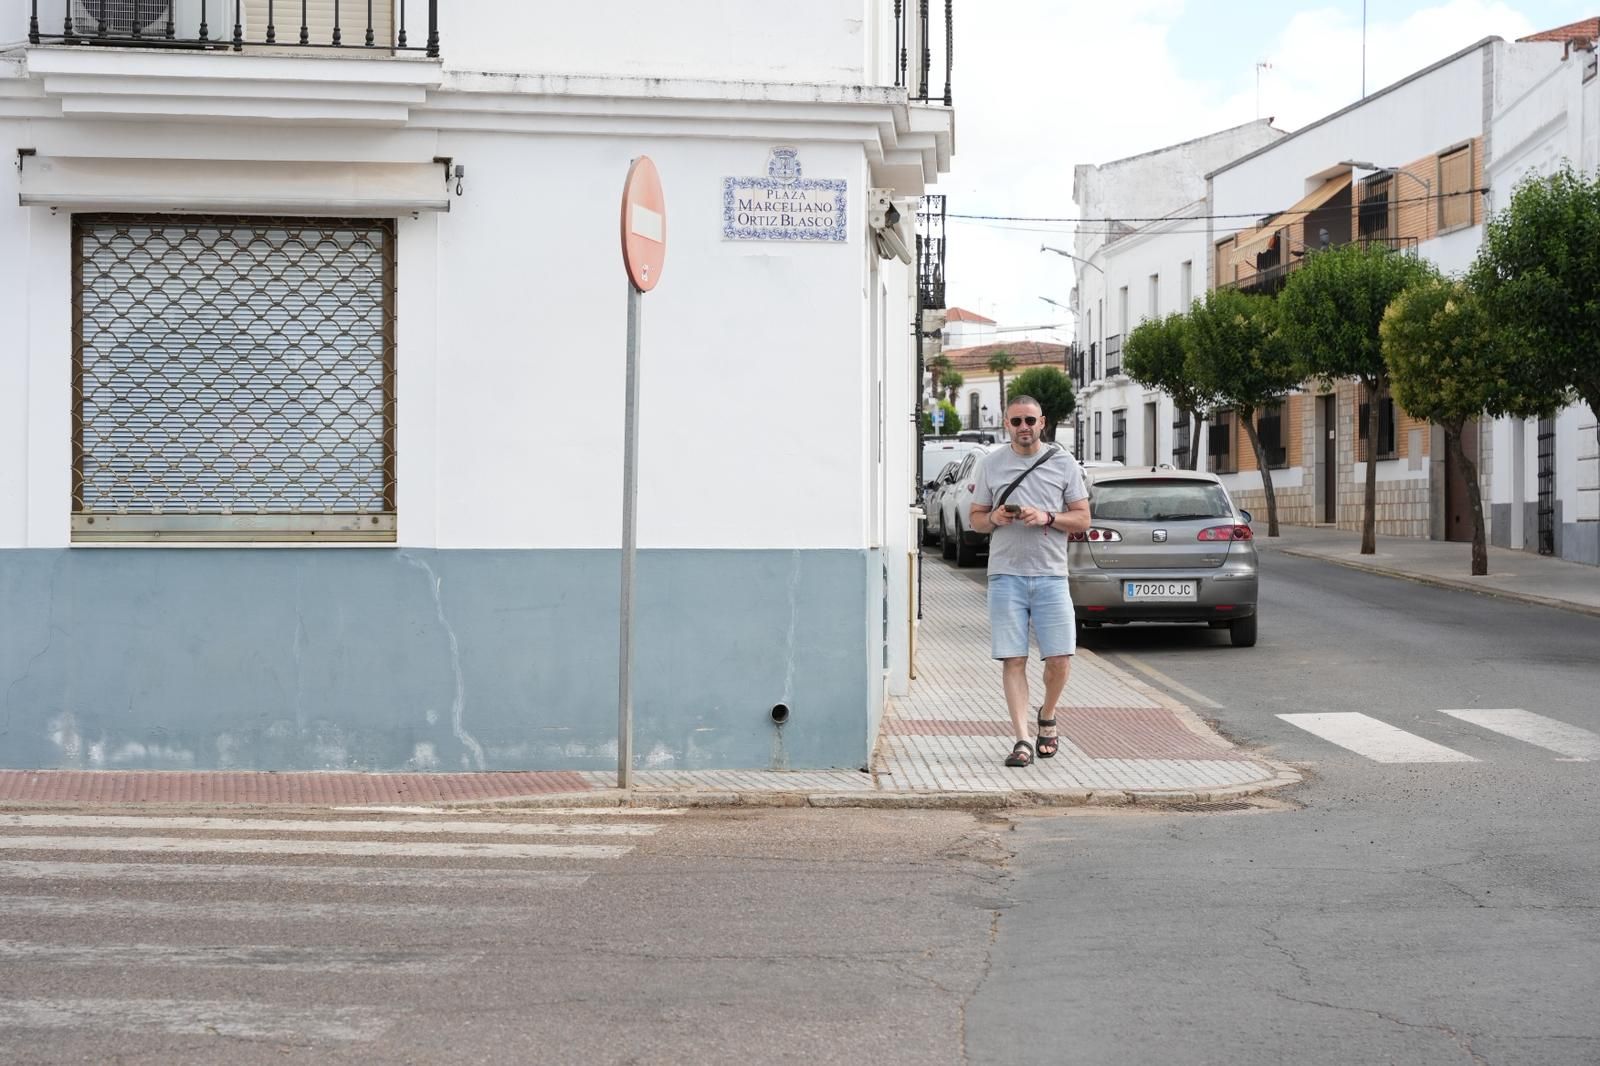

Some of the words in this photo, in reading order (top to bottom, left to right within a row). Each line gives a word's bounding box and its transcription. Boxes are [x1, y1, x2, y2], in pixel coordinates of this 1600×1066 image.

[768, 190, 806, 200] PLAZA
[738, 199, 833, 213] MARCELIANO
[738, 213, 778, 226] ORTIZ
[781, 214, 833, 227] BLASCO
[1135, 584, 1166, 595] 7020
[1168, 584, 1192, 595] CJC
